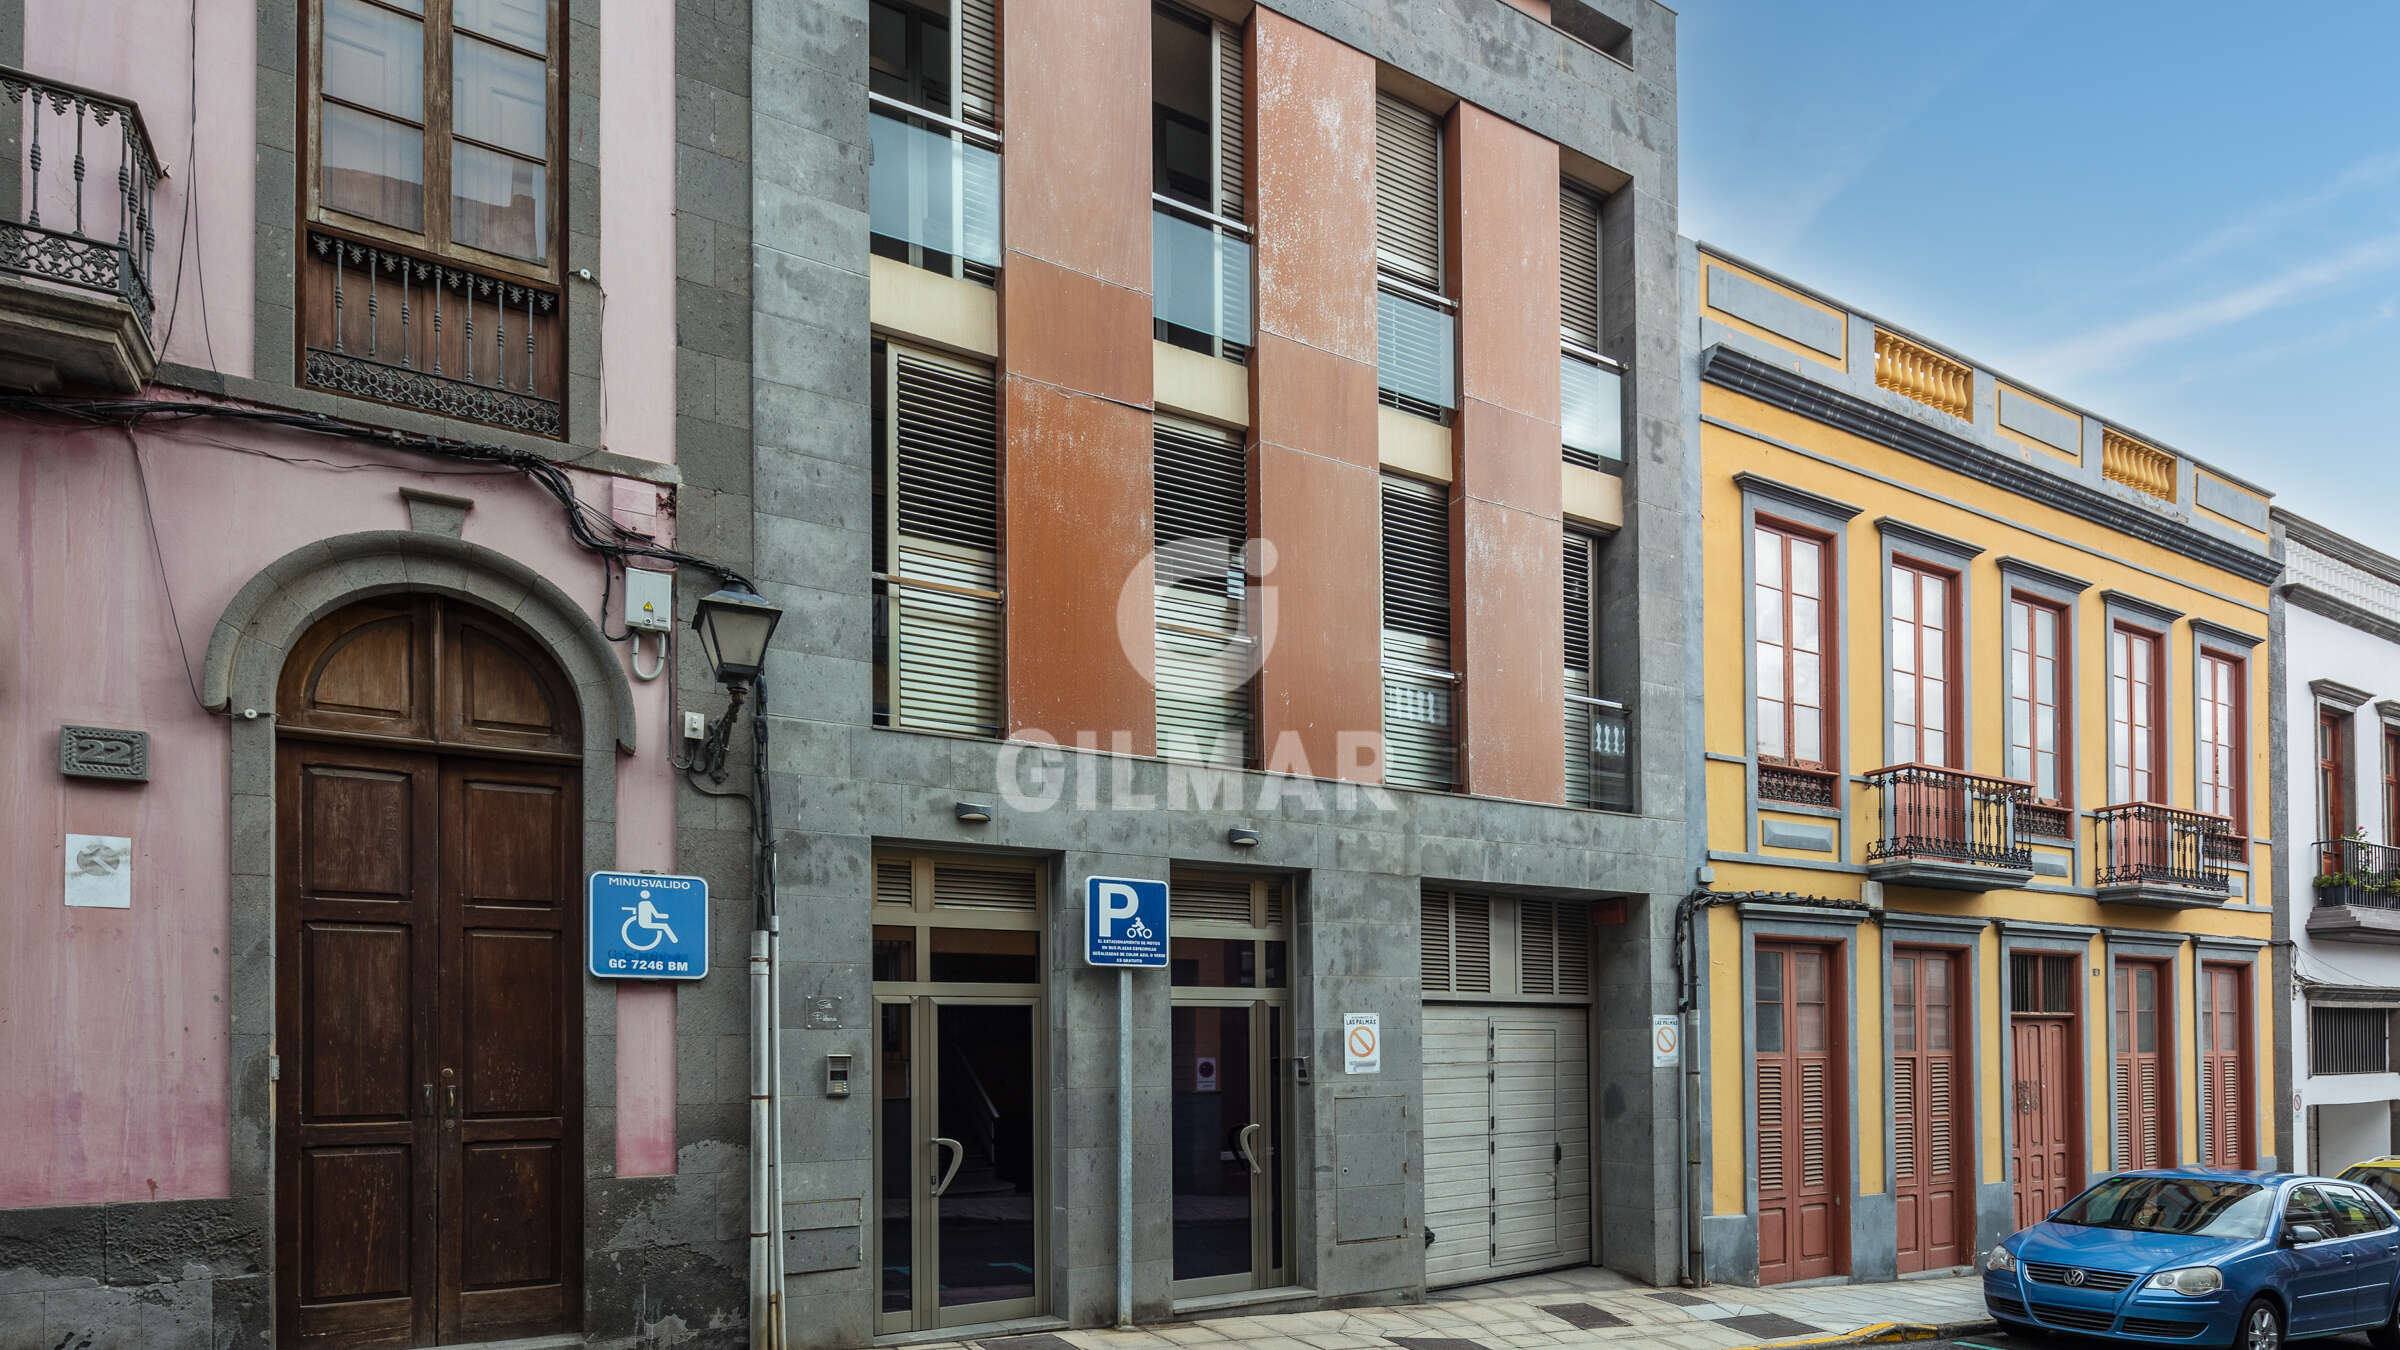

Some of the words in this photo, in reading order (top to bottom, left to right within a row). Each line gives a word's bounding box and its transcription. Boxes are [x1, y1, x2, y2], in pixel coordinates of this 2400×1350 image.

[79, 739, 131, 765] 22
[608, 877, 690, 890] MINUSVALIDO
[1098, 882, 1139, 937] P
[608, 958, 627, 969] GC
[631, 959, 664, 971] 7246
[668, 961, 688, 972] BM
